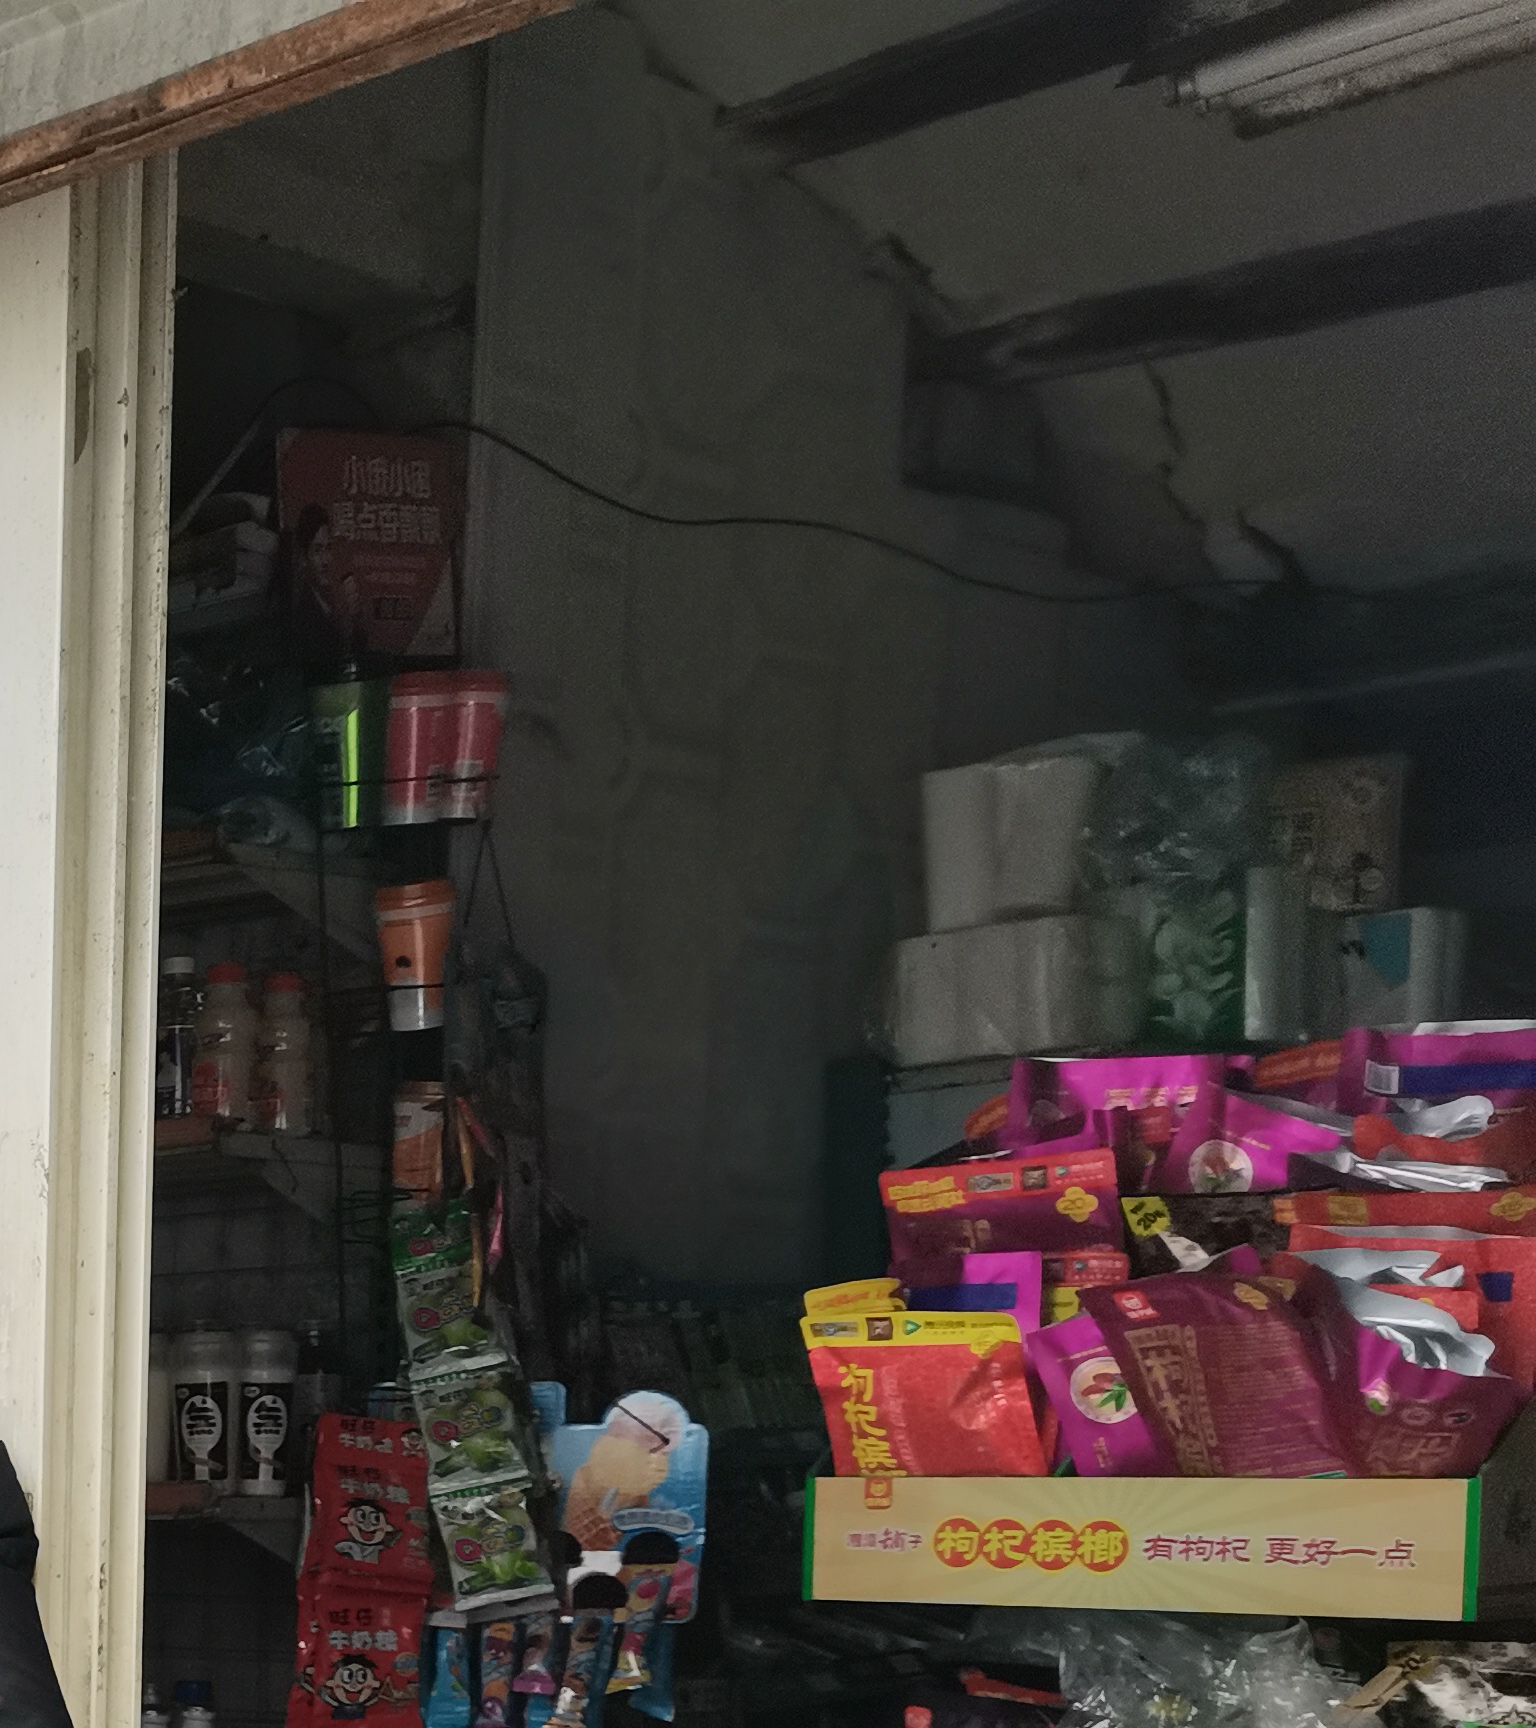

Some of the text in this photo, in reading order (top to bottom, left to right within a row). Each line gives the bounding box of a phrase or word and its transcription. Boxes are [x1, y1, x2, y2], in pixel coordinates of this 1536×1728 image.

[935, 1526, 1125, 1565] 枸杞槟榔
[1143, 1535, 1417, 1569] 有枸杞 更好一点
[328, 1607, 374, 1627] 旺仔
[328, 1629, 399, 1653] 牛奶糖
